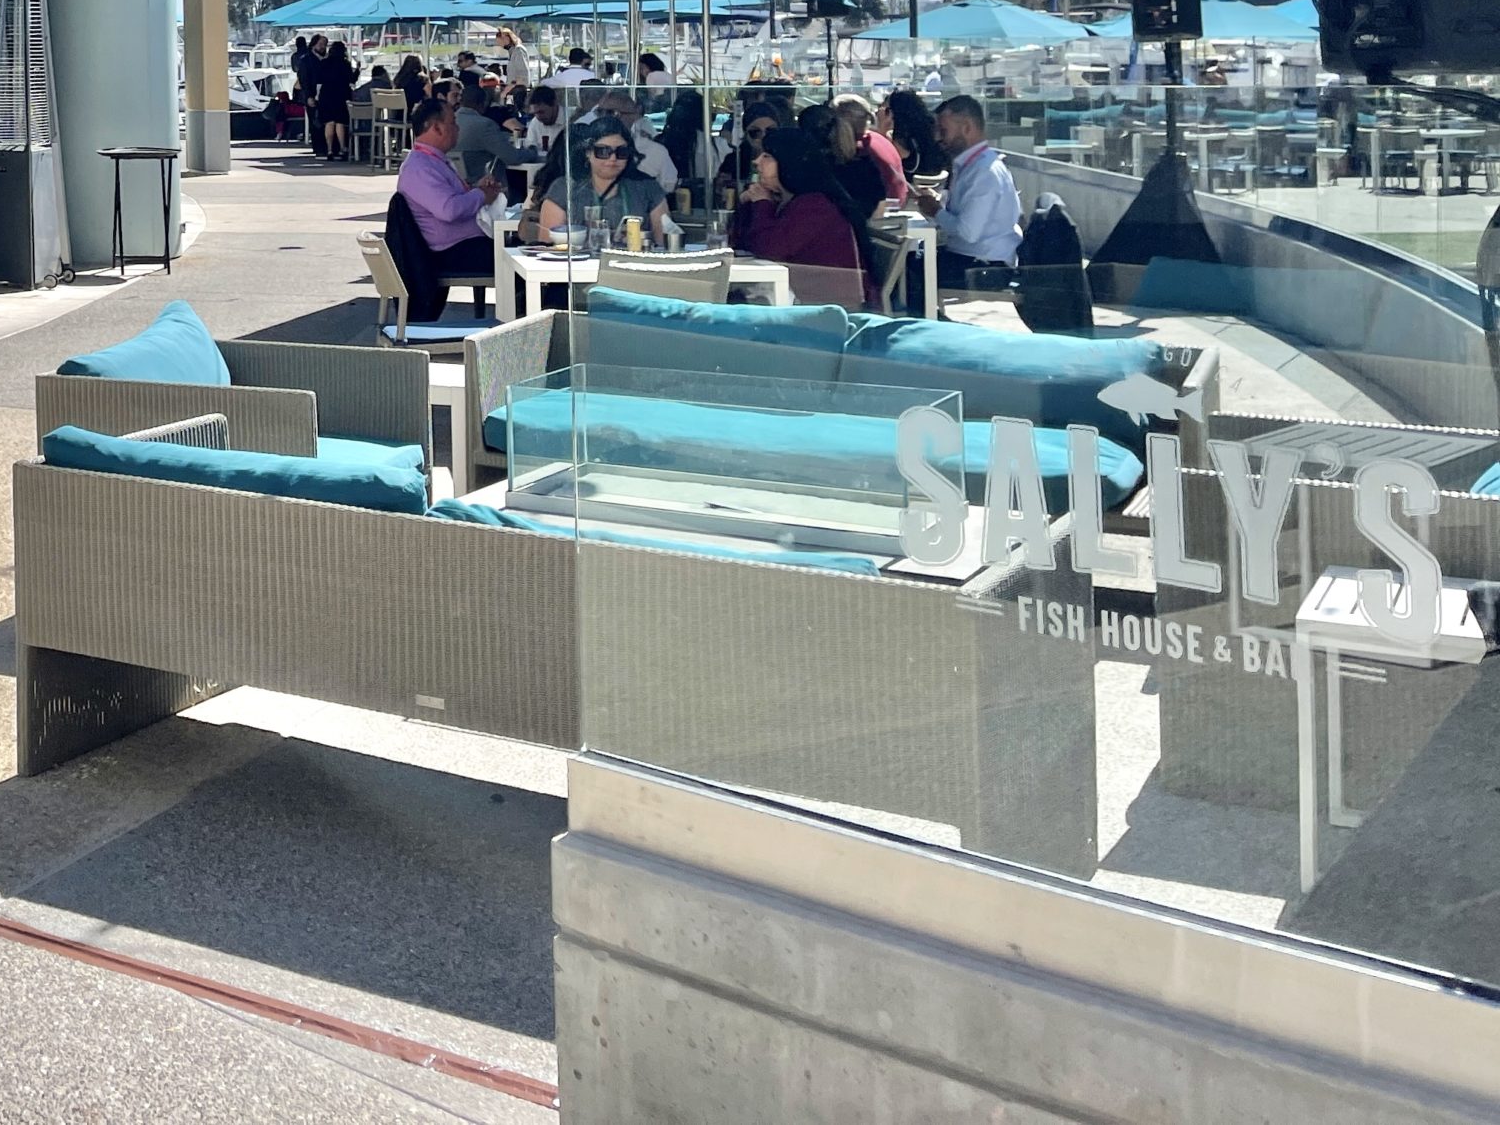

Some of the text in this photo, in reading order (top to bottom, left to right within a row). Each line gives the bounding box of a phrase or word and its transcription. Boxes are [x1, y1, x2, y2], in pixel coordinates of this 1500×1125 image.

[896, 405, 1441, 644] SALLY'S
[1017, 595, 1085, 642] FISH
[1100, 609, 1203, 663] HOUSE
[1214, 635, 1232, 663] &
